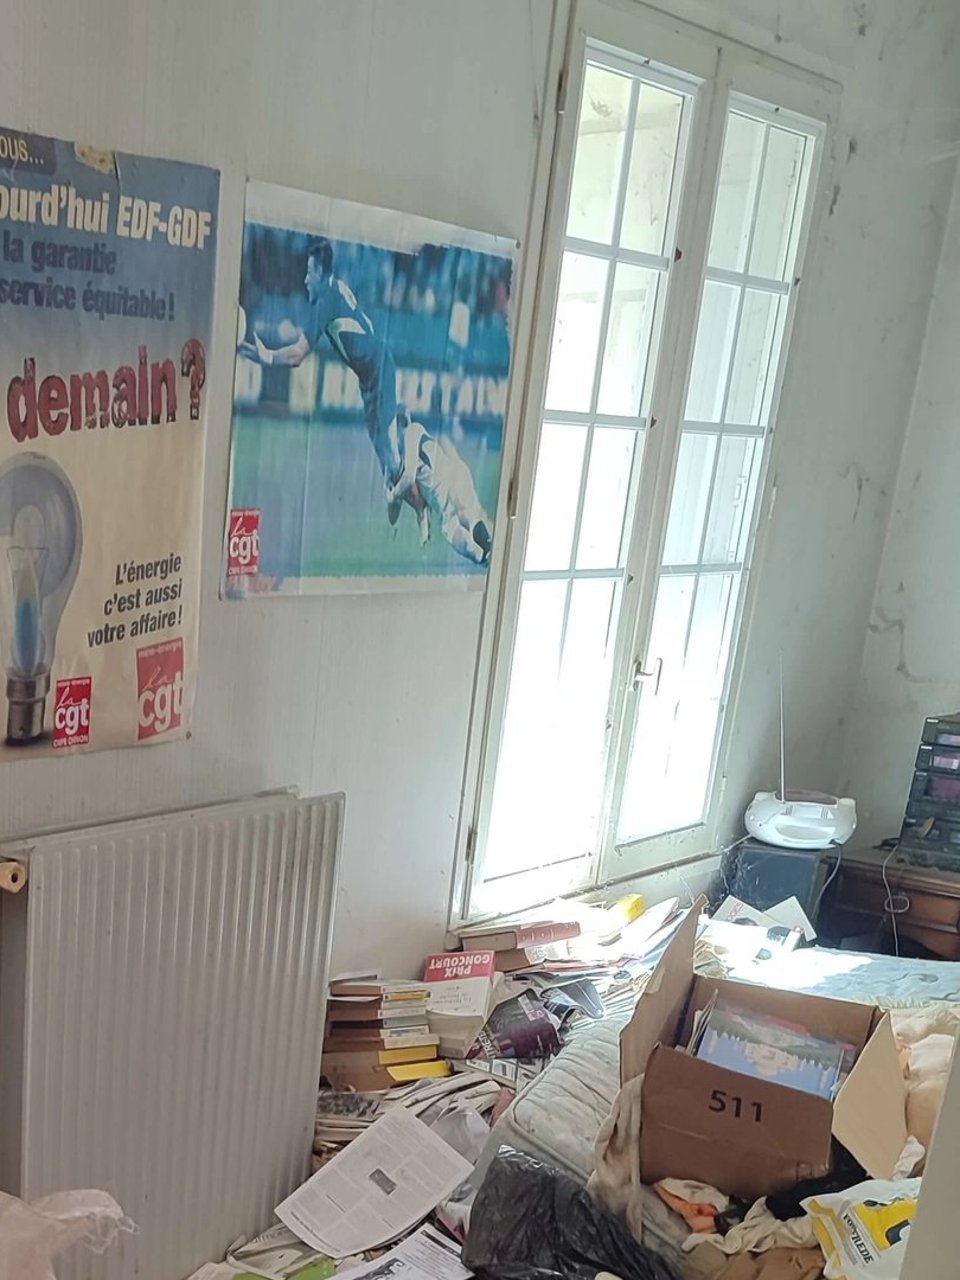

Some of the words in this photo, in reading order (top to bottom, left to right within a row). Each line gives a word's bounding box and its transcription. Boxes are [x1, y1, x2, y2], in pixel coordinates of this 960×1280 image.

[116, 195, 212, 250] EDF-GDF
[3, 230, 24, 263] la
[31, 238, 117, 275] garantie
[229, 529, 260, 565] cgt
[116, 553, 181, 586] L'énergie
[104, 592, 141, 616] c'est
[146, 579, 182, 606] aussi
[88, 623, 125, 648] votre
[55, 698, 89, 735] cgt
[139, 671, 183, 732] cgt
[429, 954, 490, 970] GONCOURT
[444, 965, 471, 978] PRIX
[707, 1089, 764, 1123] 511
